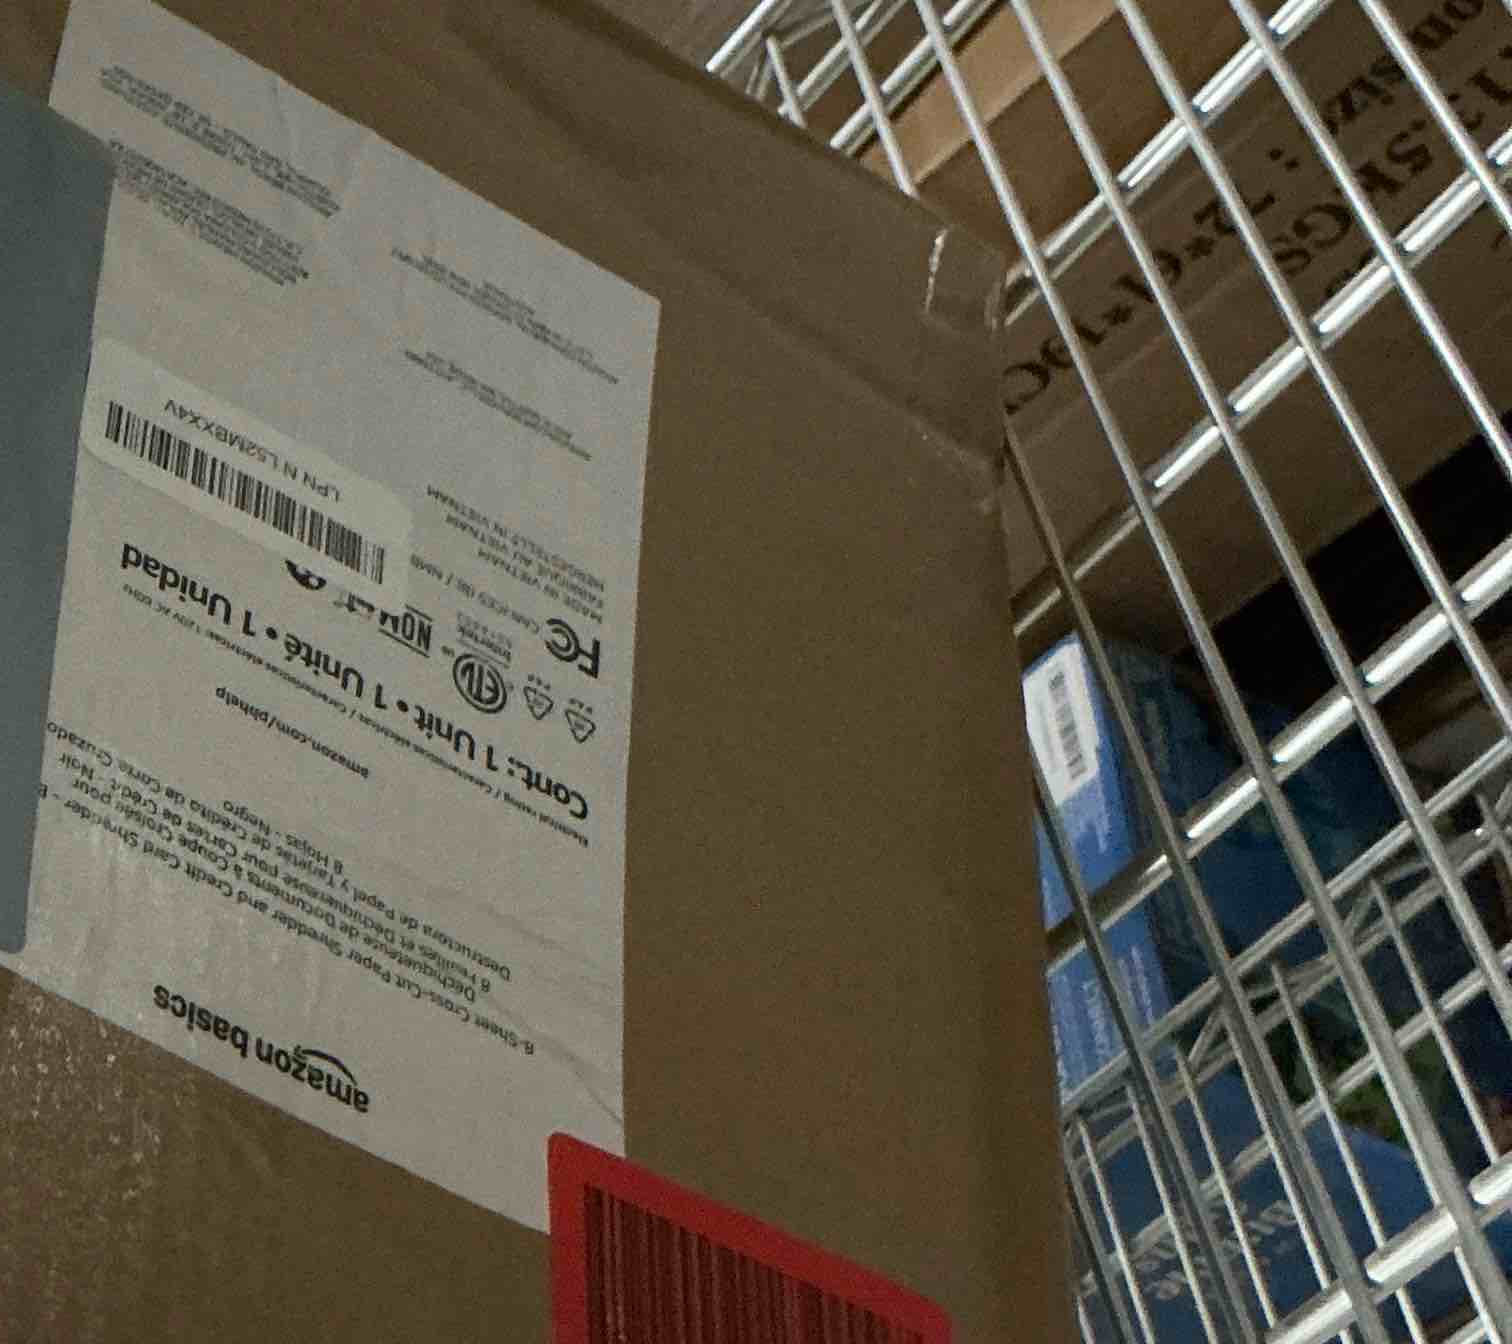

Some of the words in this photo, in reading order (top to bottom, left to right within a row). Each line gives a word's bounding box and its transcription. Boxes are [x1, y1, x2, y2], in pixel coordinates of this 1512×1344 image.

[284, 460, 296, 482] N
[303, 470, 338, 506] LPN
[120, 538, 231, 628] Unidad
[477, 545, 538, 590] VIETNAM
[241, 607, 255, 639] 1
[284, 630, 363, 702] Unité
[374, 681, 386, 712] 1
[46, 720, 111, 769] Cruzado
[214, 682, 368, 783] amazon.com/phhelp
[413, 702, 475, 765] Unit
[485, 743, 497, 774] 1
[71, 773, 110, 808] pour
[164, 785, 184, 810] de
[506, 753, 588, 825] Cont.:
[162, 807, 181, 830] de
[222, 793, 269, 837] Negro
[143, 837, 179, 872] Card
[177, 830, 228, 873] Coupe
[251, 830, 270, 854] de
[241, 847, 277, 881] pour
[237, 887, 267, 917] and
[247, 869, 335, 930] Documents
[352, 883, 394, 921] Papel
[271, 907, 342, 959] Shredder
[339, 919, 358, 942] de
[399, 910, 417, 934] de
[345, 943, 390, 984] Paper
[152, 981, 248, 1059] basics
[255, 1036, 369, 1117] amazon
